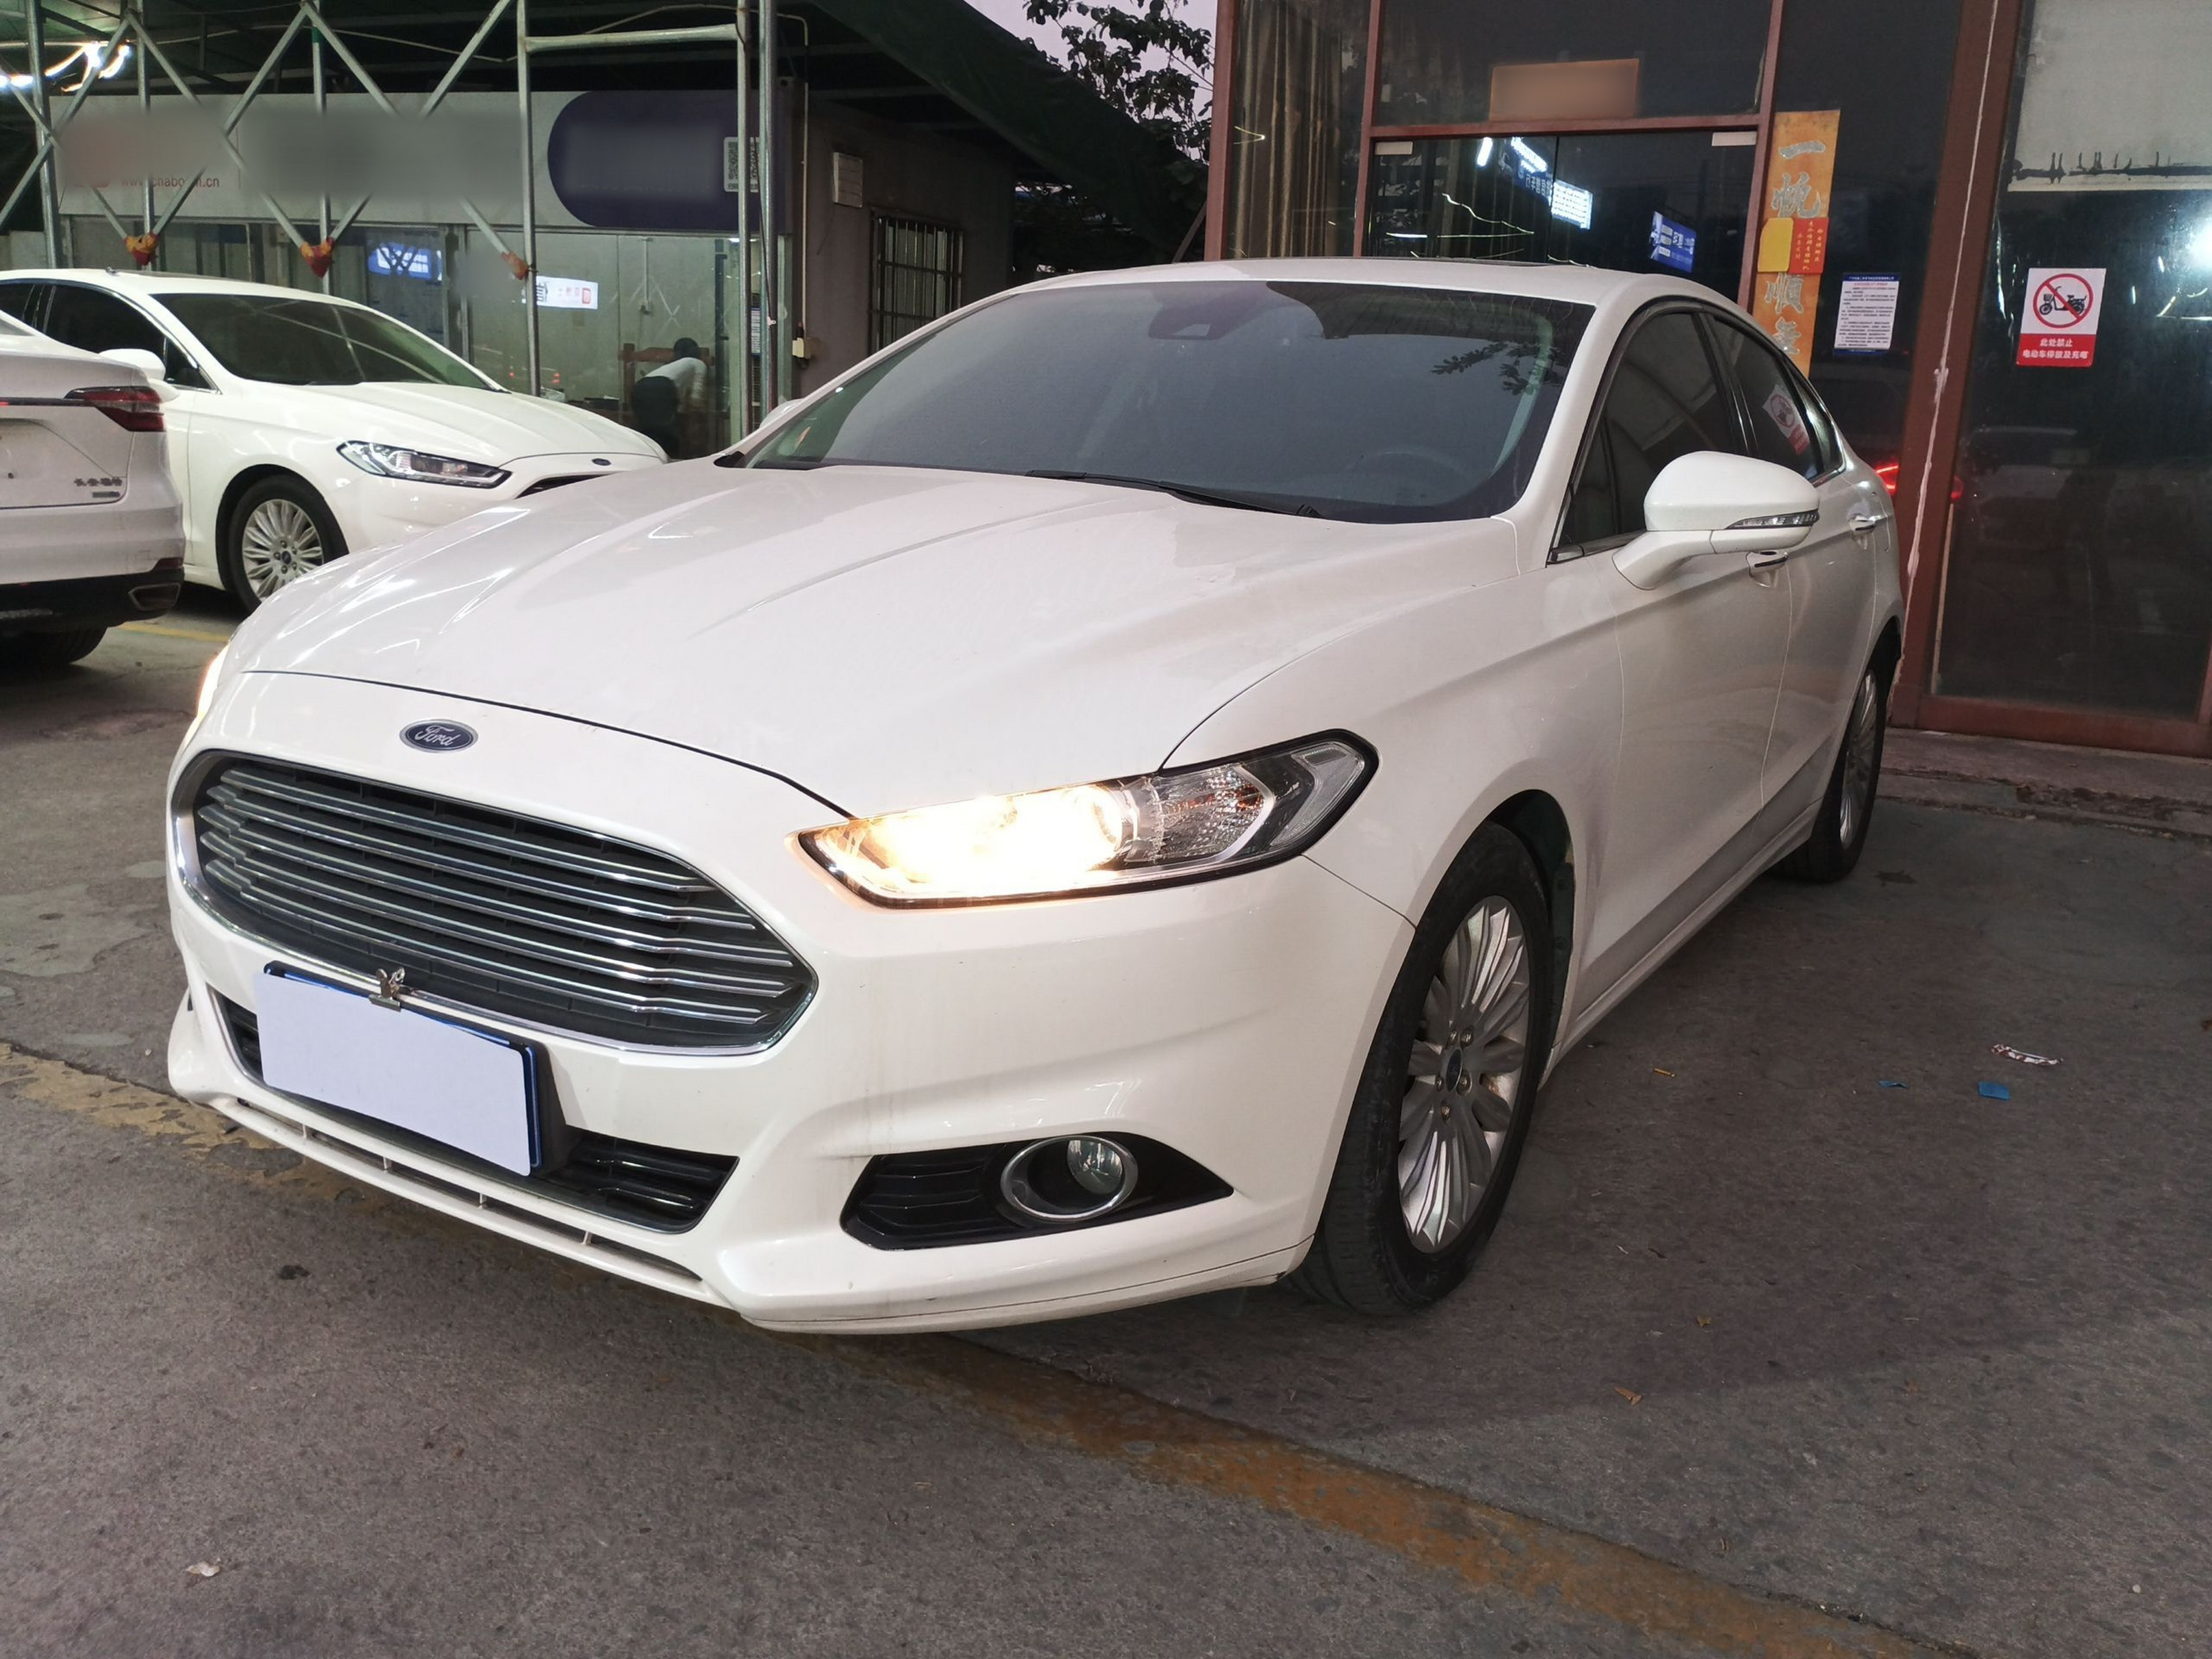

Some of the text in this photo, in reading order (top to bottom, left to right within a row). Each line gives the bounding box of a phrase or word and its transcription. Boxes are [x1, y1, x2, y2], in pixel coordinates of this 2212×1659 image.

[2040, 338, 2073, 347] 此处禁止
[414, 725, 461, 746] Ford
